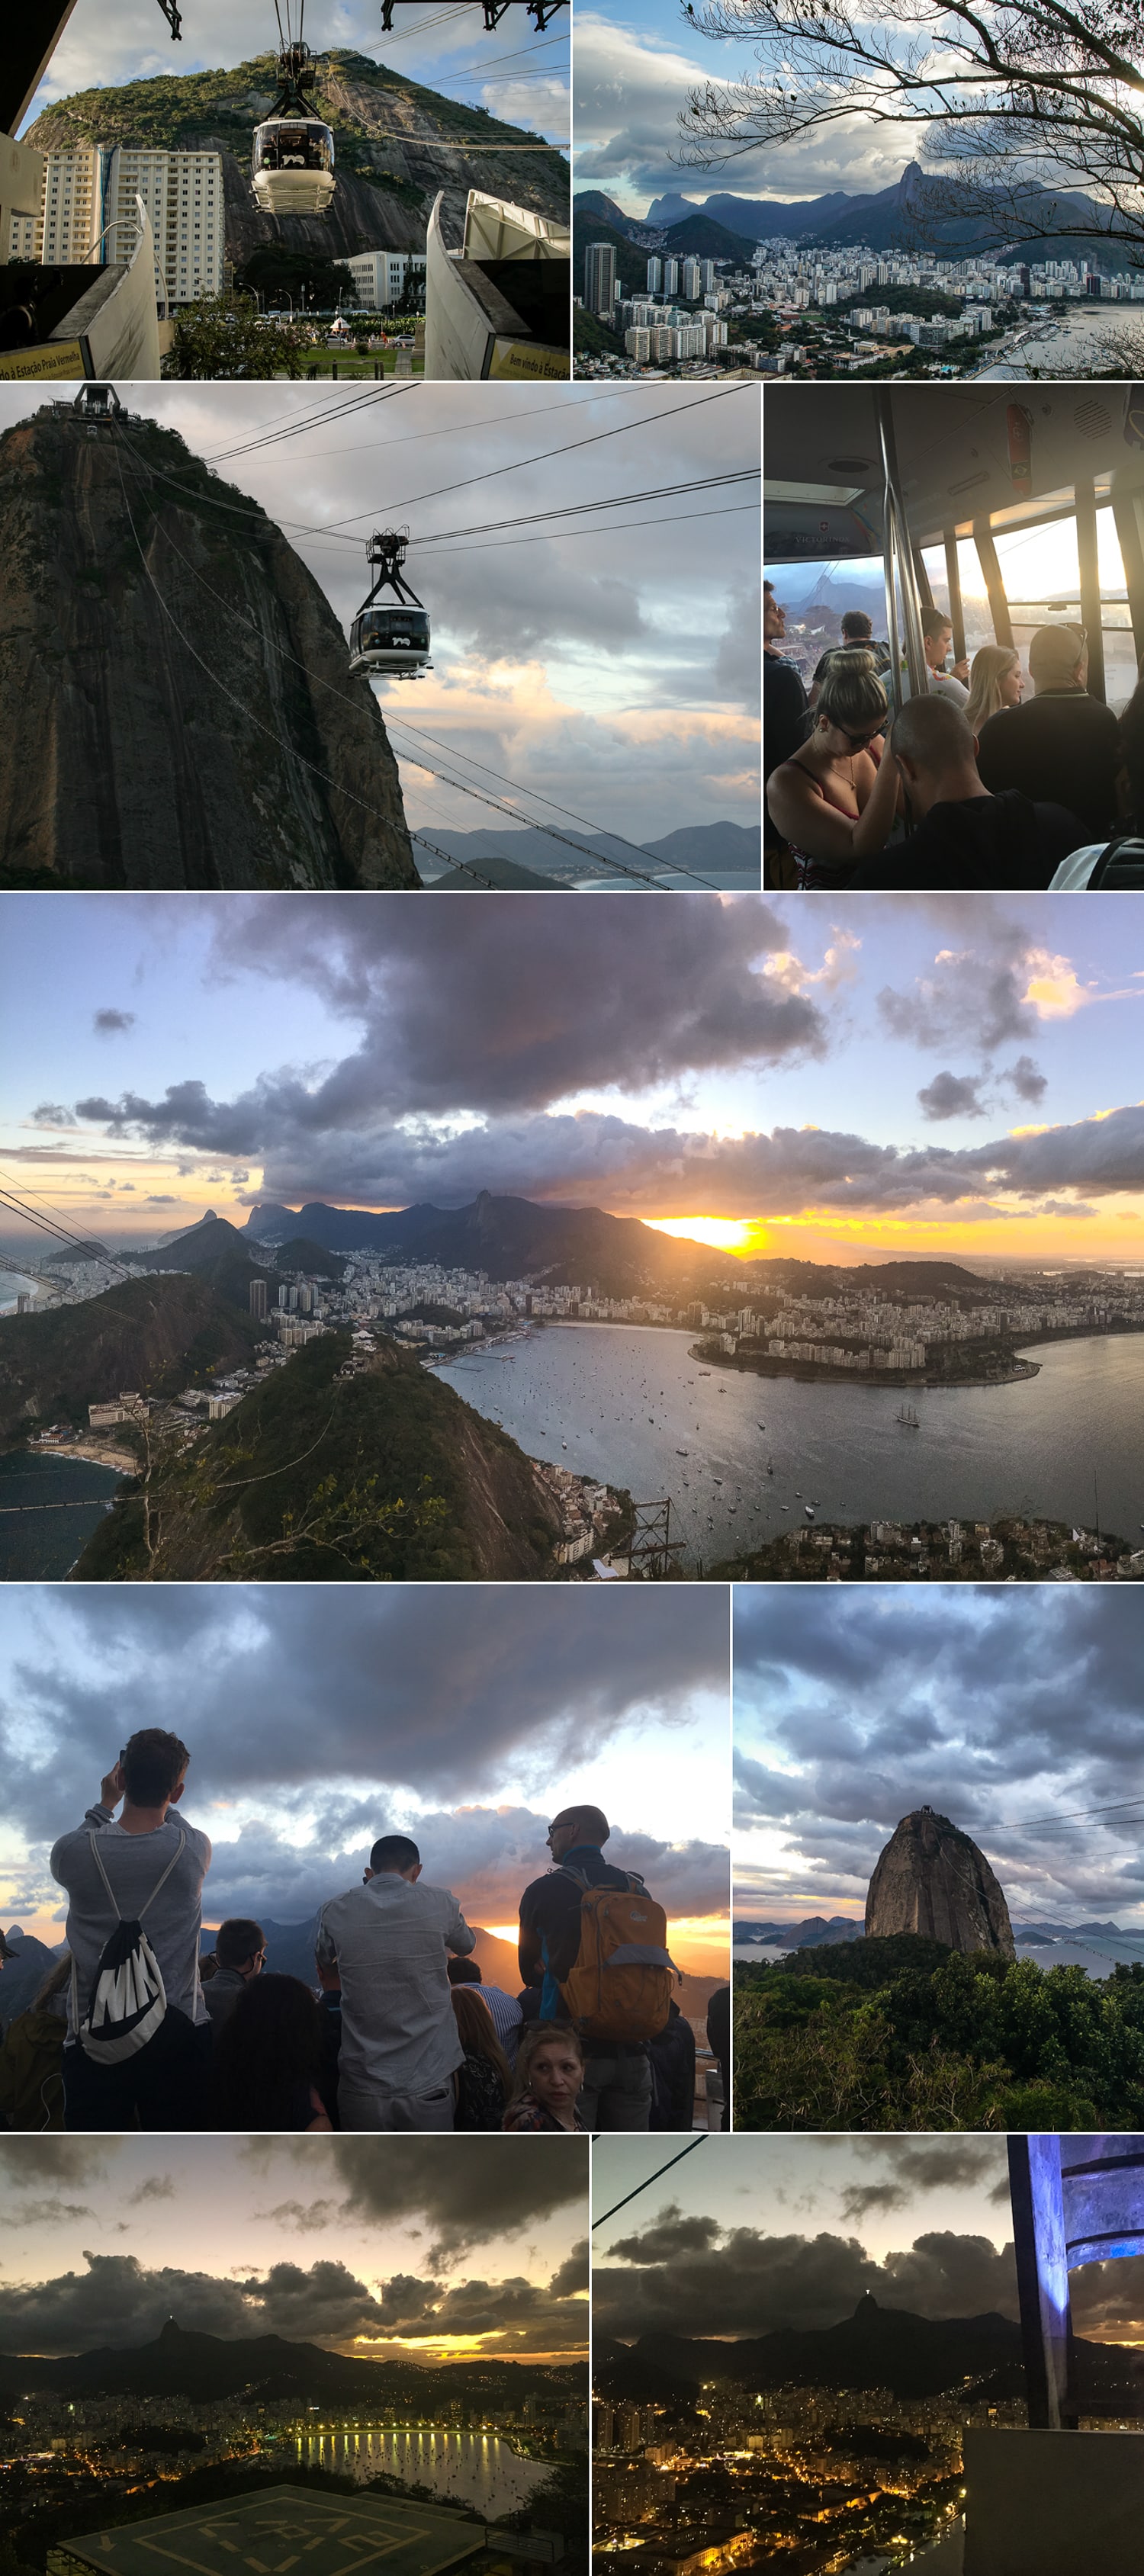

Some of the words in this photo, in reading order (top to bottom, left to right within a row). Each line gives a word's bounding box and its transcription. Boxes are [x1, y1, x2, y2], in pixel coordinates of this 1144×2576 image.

[16, 361, 43, 377] Estação
[42, 357, 57, 371] Praia
[56, 352, 81, 366] Vermelha
[510, 353, 522, 367] Bem
[522, 357, 538, 373] vindo
